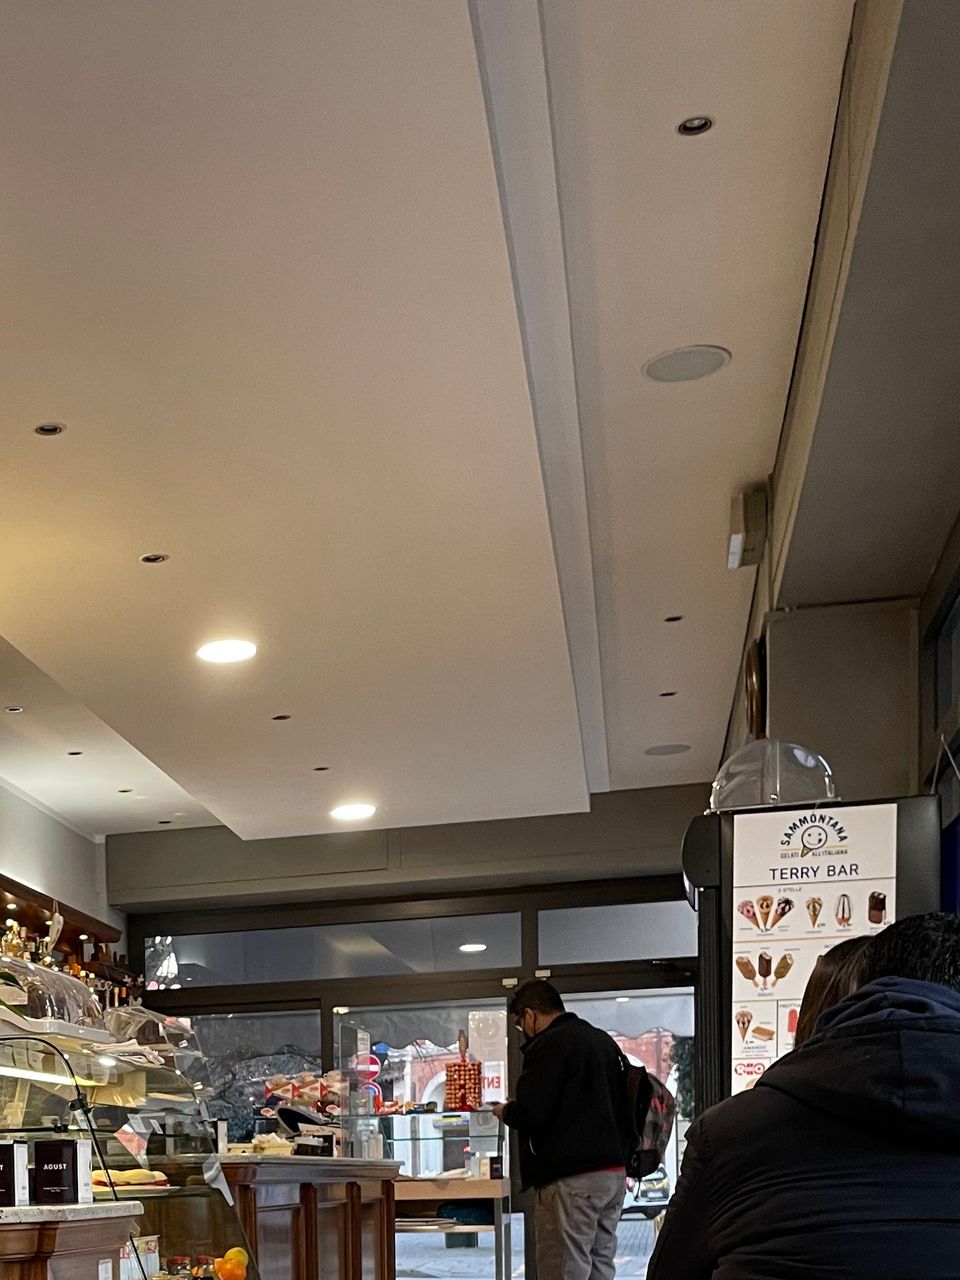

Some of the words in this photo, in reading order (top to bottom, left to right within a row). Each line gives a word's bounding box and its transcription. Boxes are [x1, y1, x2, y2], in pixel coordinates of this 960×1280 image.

[781, 813, 848, 846] SAMMONTANA
[769, 865, 820, 880] TERRY
[827, 863, 859, 877] BAR
